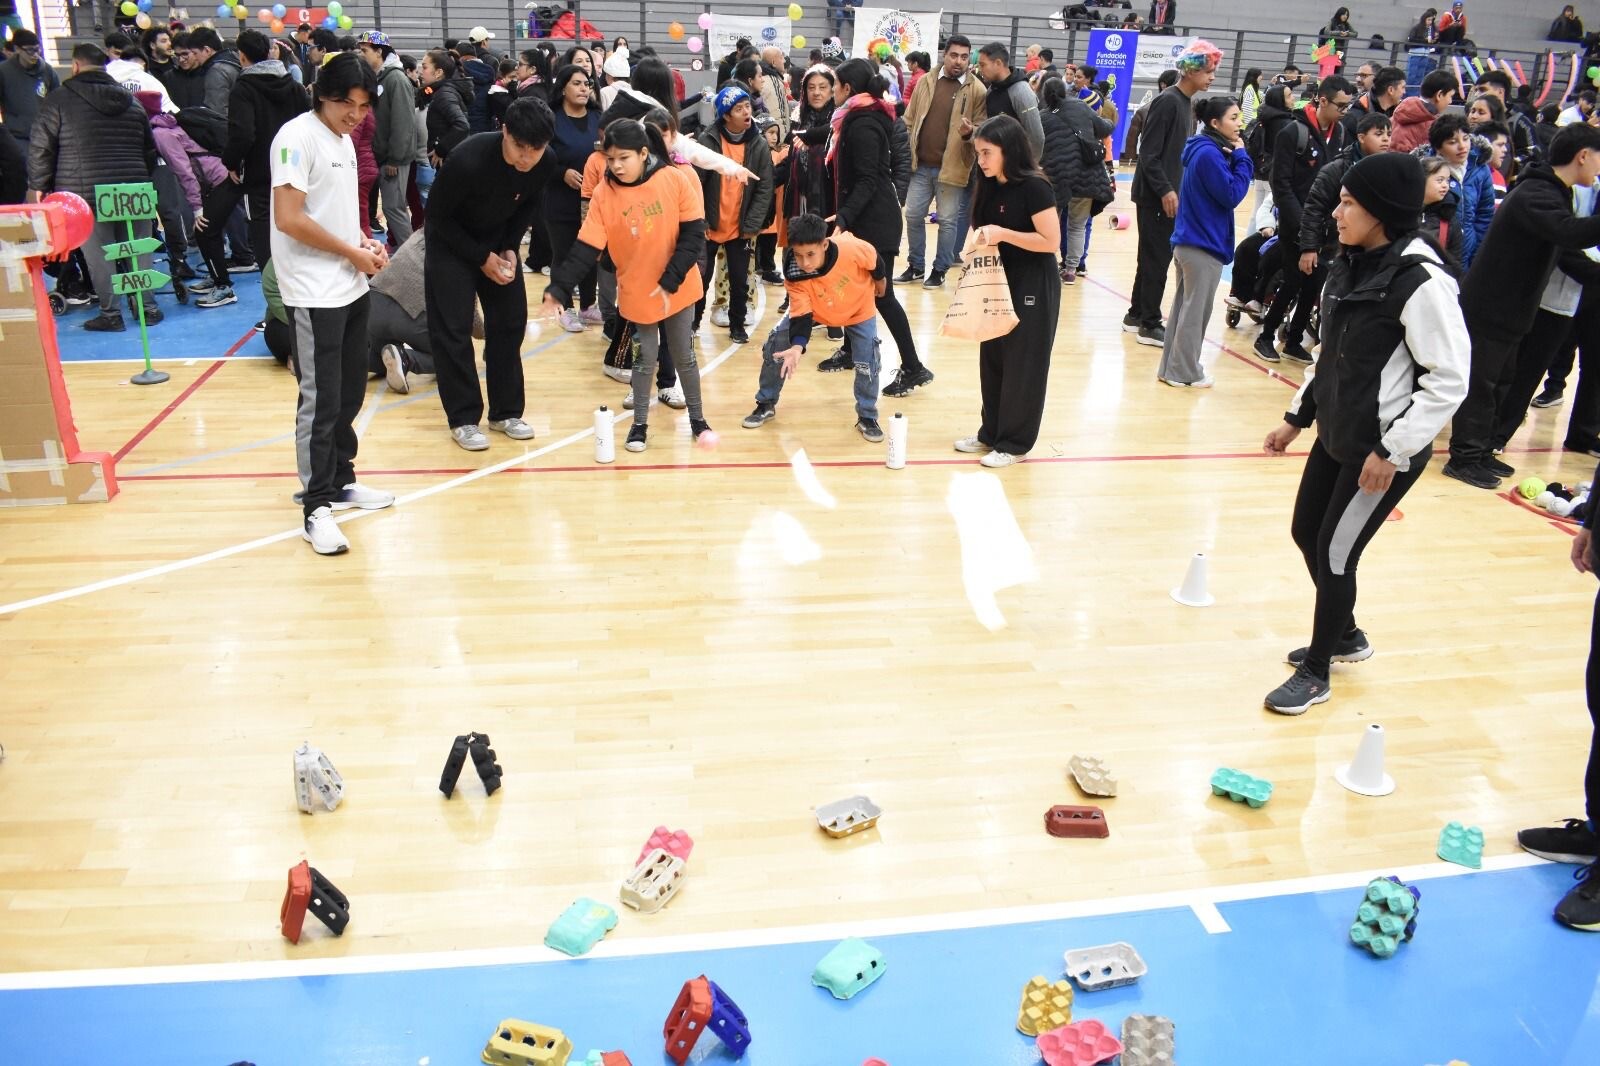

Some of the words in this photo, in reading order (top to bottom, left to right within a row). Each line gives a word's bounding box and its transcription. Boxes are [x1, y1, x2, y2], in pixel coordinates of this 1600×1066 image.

[1096, 51, 1127, 59] Fundación
[1095, 58, 1126, 66] DESOCHA
[118, 242, 140, 256] AL
